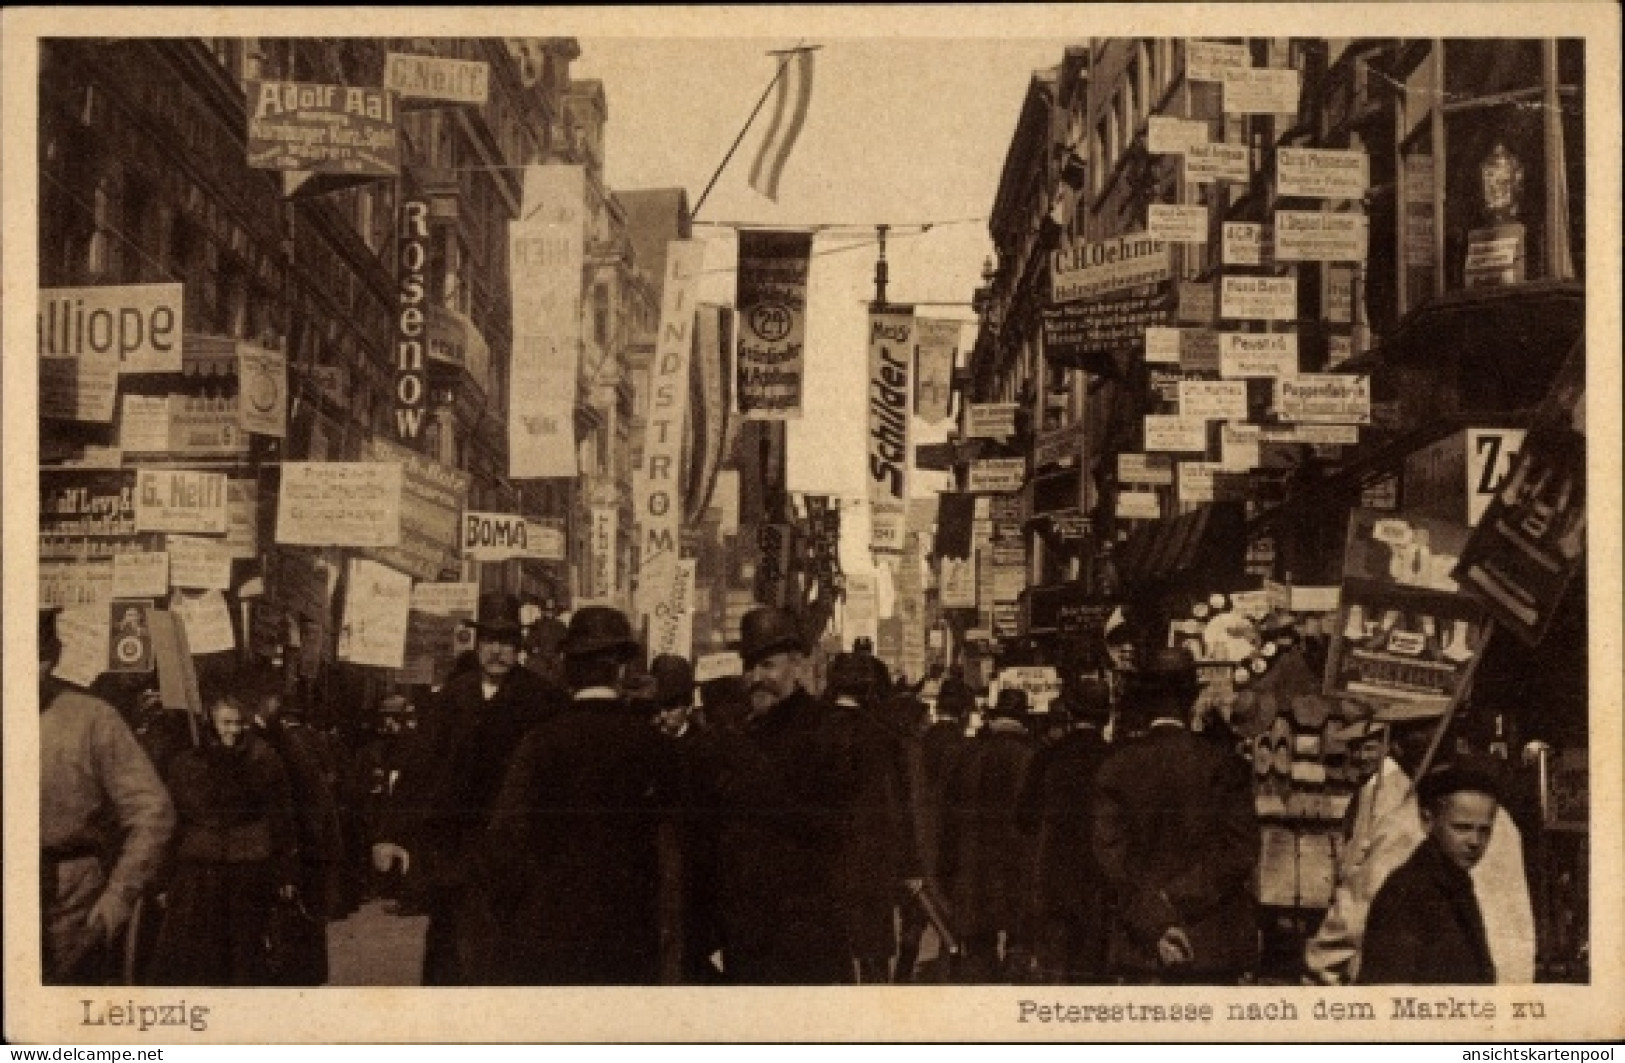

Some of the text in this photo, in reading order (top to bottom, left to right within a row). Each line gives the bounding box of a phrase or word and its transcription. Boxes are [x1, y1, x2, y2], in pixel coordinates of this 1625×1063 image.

[254, 82, 393, 124] Adolf Aal
[38, 299, 175, 361] lliope
[397, 202, 429, 437] Rosenow
[759, 310, 786, 334] 24
[871, 347, 907, 497] Schilder
[466, 514, 528, 550] BOMA
